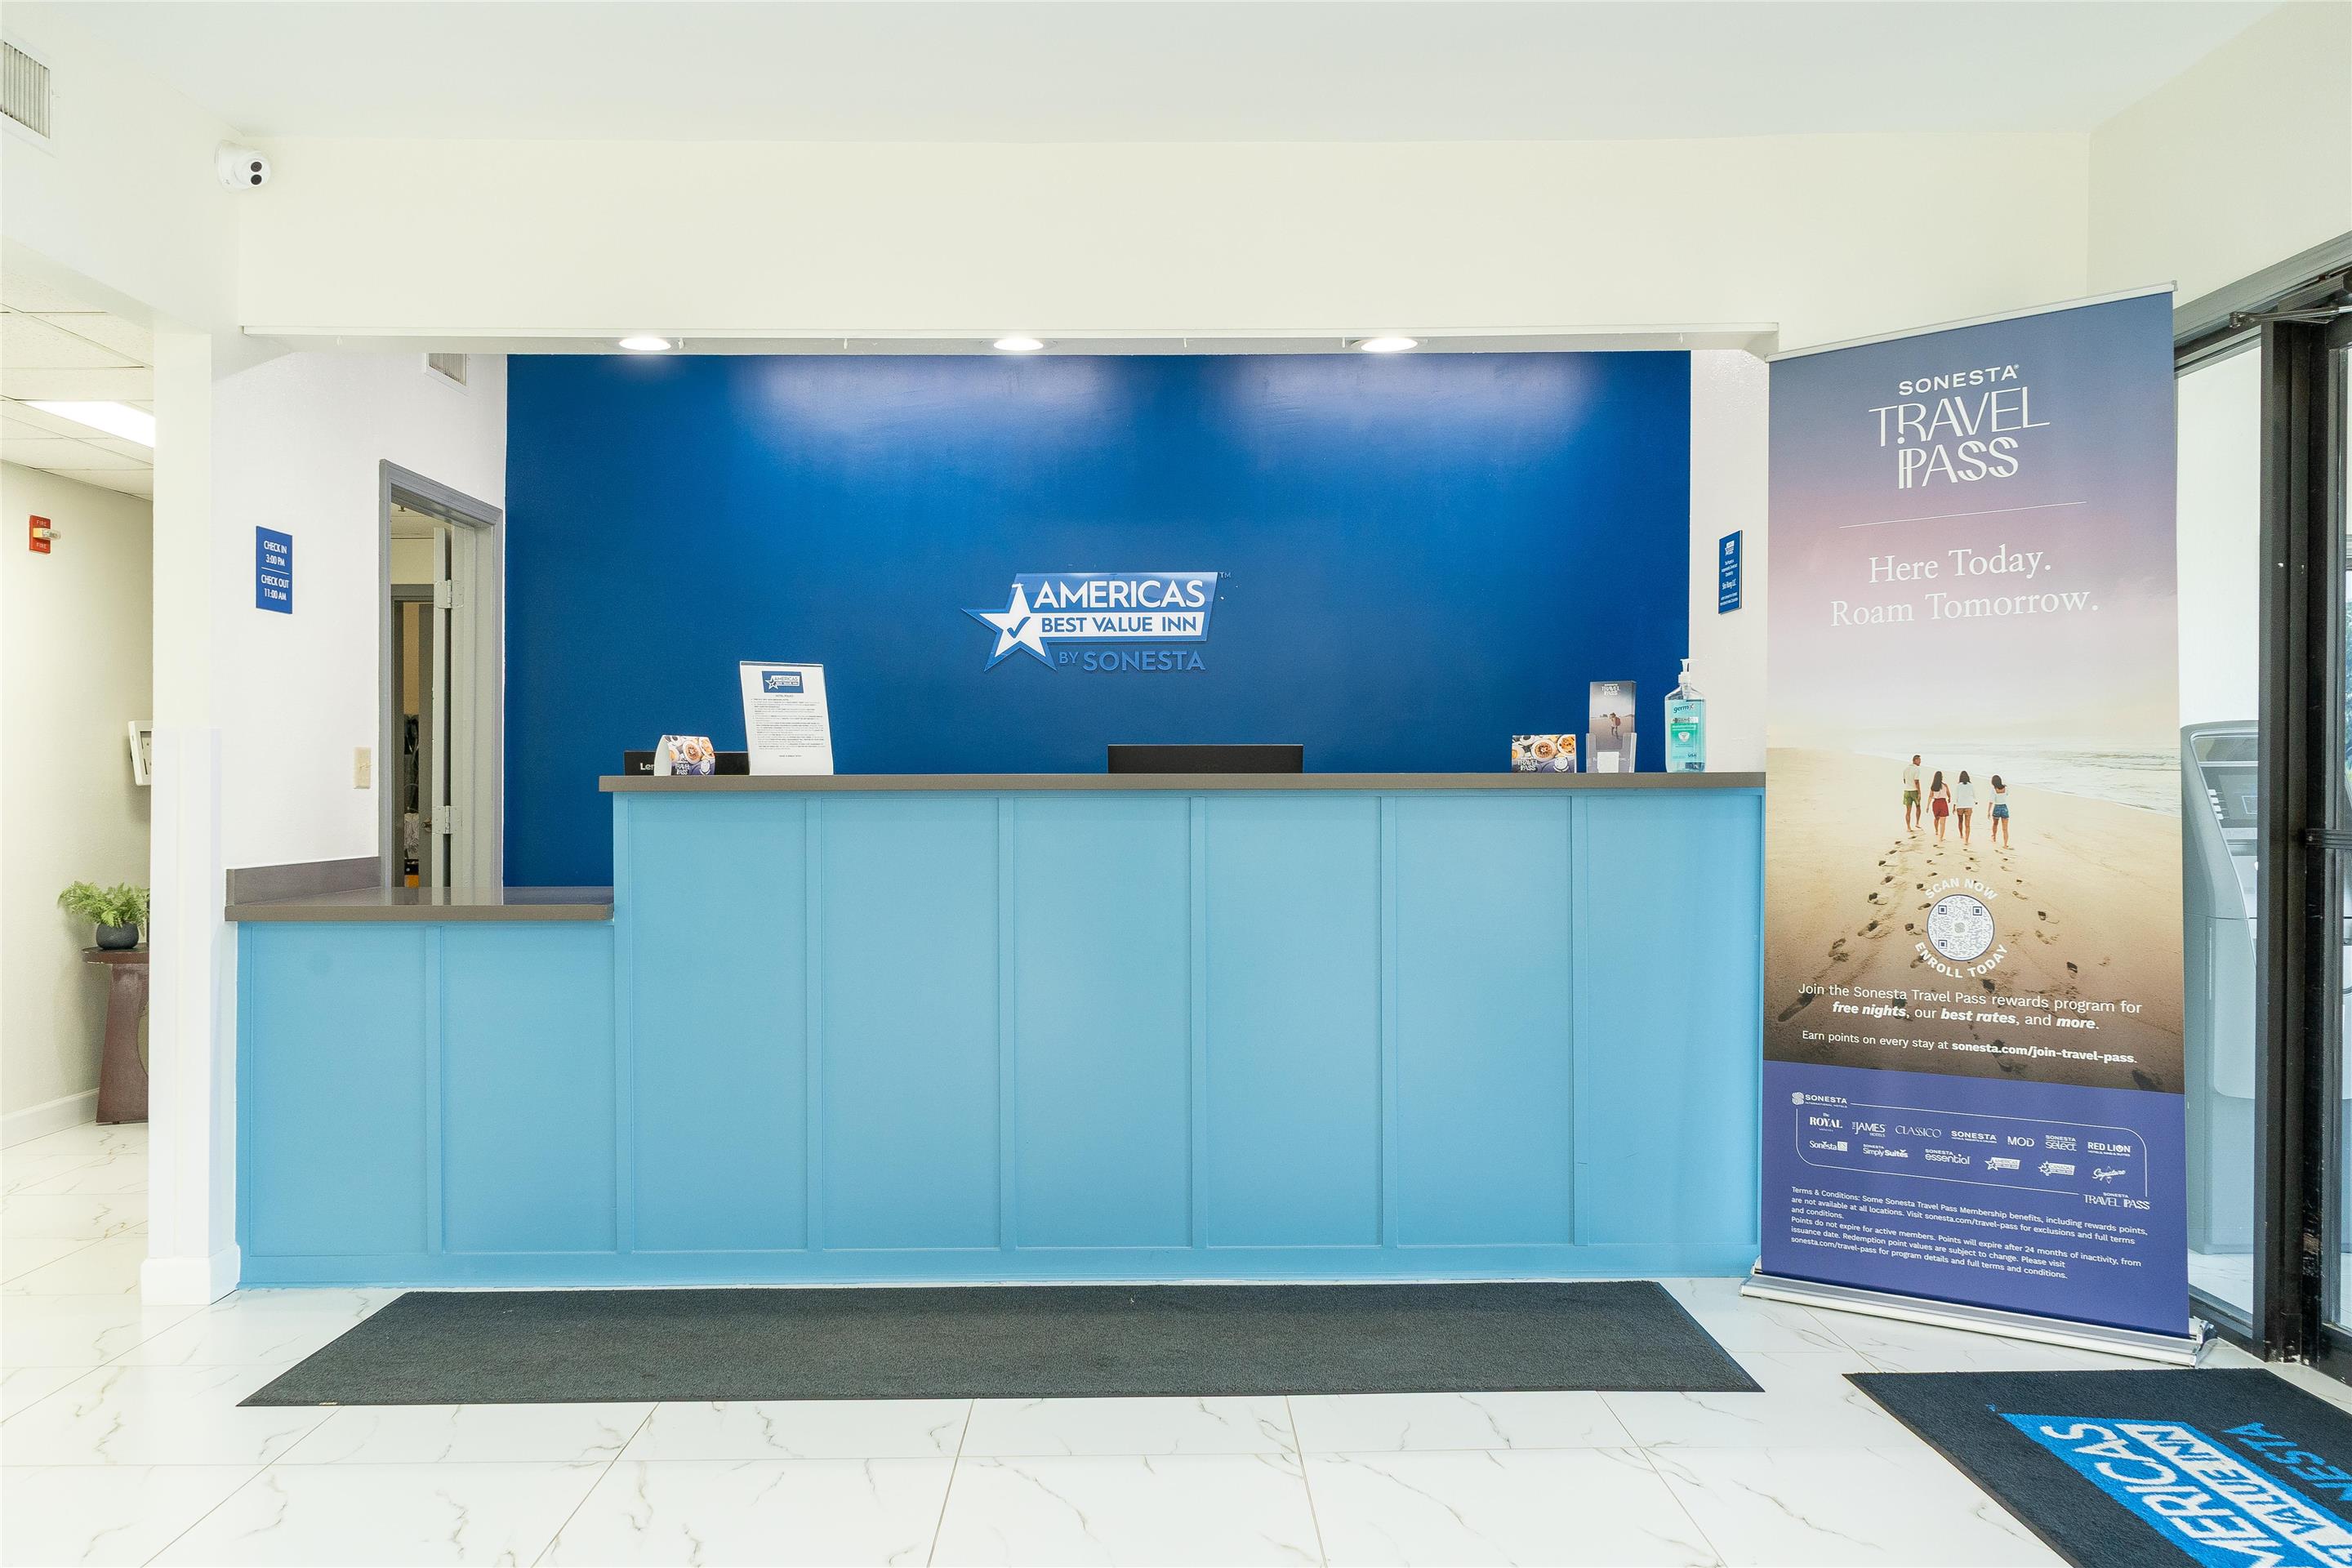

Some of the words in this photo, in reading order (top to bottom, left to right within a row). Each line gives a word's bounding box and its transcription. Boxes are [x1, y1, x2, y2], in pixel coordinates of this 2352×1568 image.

[1898, 365, 2018, 396] SONESTA
[1869, 385, 2051, 448] TRAVEL
[1898, 436, 2019, 489] PASS
[264, 540, 281, 553] CHECK
[280, 545, 287, 555] IN
[265, 554, 277, 565] 3:00
[278, 557, 285, 567] PM
[1869, 554, 1939, 584] Here
[1948, 542, 2051, 579] Today.
[261, 574, 278, 586] CHECK
[278, 578, 289, 589] OUT
[264, 588, 278, 599] 11:00
[278, 591, 287, 601] AM
[1033, 580, 1205, 608] AMERICAS
[1830, 600, 1915, 627] Roam
[1925, 590, 2099, 621] Tomorrow.
[1041, 617, 1087, 632] BEST
[1092, 617, 1153, 632] VALUE
[1162, 616, 1196, 632] INN
[1059, 652, 1079, 664] BY
[1083, 651, 1206, 670] SONESTA
[1924, 877, 1960, 899] SCAN
[1964, 878, 1999, 900] NOW
[1914, 942, 1963, 978] ENROLL
[1967, 944, 2008, 978] TODAY
[1798, 983, 1824, 995] Join
[1829, 984, 1850, 996] the
[1854, 987, 1907, 1000] Sonesta
[1911, 989, 1950, 1003] Travel
[1955, 991, 1987, 1004] Pass
[1992, 996, 2049, 1008] rewards
[2054, 999, 2115, 1013] program
[2120, 1000, 2142, 1013] for
[1832, 1001, 1859, 1014] free
[1862, 1004, 1910, 1018] nights,
[1914, 1009, 1937, 1018] our
[1940, 1008, 1973, 1022] best
[1976, 1012, 2020, 1026] rates,
[2025, 1013, 2051, 1027] and
[2056, 1018, 2100, 1030] more.
[1802, 1030, 1824, 1040] Earn
[1828, 1031, 1860, 1044] points
[1863, 1036, 1876, 1045] on
[1879, 1037, 1909, 1049] every
[1912, 1039, 1935, 1051] stay
[1937, 1041, 1949, 1050] at
[1952, 1042, 2138, 1064] sonesta.com/join-travel-pass.
[1805, 1094, 1847, 1104] SONESTA
[1809, 1116, 1843, 1129] ROYAL
[1855, 1121, 1886, 1134] JAMES
[1895, 1125, 1942, 1138] CLASSICO
[1809, 1140, 1837, 1151] Sonesta
[1950, 1130, 1997, 1141] SONESTA
[2007, 1136, 2035, 1147] MOD
[1863, 1148, 1885, 1157] Simply
[1885, 1149, 1908, 1158] Suites
[2046, 1141, 2078, 1152] select
[2087, 1142, 2105, 1151] RED
[2107, 1144, 2131, 1153] LION
[1925, 1153, 1971, 1165] essential
[1792, 1187, 1812, 1195] Terms
[1821, 1191, 1860, 1200] Conditions:
[1862, 1195, 1883, 1204] Some
[1885, 1198, 1915, 1207] Sonesta
[1917, 1201, 1939, 1210] Travel
[1960, 1207, 2007, 1219] Membership
[2009, 1212, 2043, 1223] benefits,
[2046, 1216, 2082, 1228] including
[2084, 1223, 2117, 1232] rewards
[2119, 1226, 2148, 1236] points,
[2083, 1194, 2122, 1208] TRAVEL
[2124, 1198, 2150, 1210] PASS
[1806, 1209, 1844, 1219] conditions.
[1818, 1201, 1847, 1209] available
[1869, 1206, 1904, 1216] locations.
[1906, 1210, 1923, 1218] Visit
[1925, 1214, 2018, 1230] sonesta.com/travel-pass
[2034, 1227, 2075, 1236] exclusions
[2095, 1232, 2108, 1241] full
[2110, 1236, 2136, 1245] terms
[1791, 1216, 1813, 1225] Points
[1839, 1223, 1861, 1232] expire
[1875, 1227, 1896, 1236] active
[1899, 1231, 1936, 1241] members.
[1938, 1235, 1962, 1244] Points
[1979, 1241, 2002, 1250] expire
[2005, 1244, 2023, 1252] after
[2037, 1248, 2068, 1258] months
[2081, 1253, 2118, 1265] inactivity,
[2120, 1258, 2141, 1267] from
[1791, 1226, 1821, 1236] issuance
[1823, 1230, 1841, 1239] date.
[1842, 1233, 1886, 1244] Redemption
[1888, 1240, 1907, 1248] point
[1909, 1242, 1932, 1250] values
[1949, 1247, 1976, 1257] subject
[1989, 1253, 2019, 1263] change.
[2021, 1256, 2047, 1265] Please
[2048, 1259, 2065, 1268] visit
[1791, 1237, 1877, 1254] sonesta.com/travel-pass
[1878, 1247, 1889, 1255] for
[1891, 1250, 1922, 1259] program
[1924, 1254, 1949, 1263] details
[1967, 1259, 1980, 1267] full
[1981, 1262, 2005, 1271] terms
[2024, 1268, 2069, 1279] conditions.
[2137, 1426, 2222, 1462] INN
[2039, 1423, 2314, 1568] MERICAS
[2197, 1469, 2328, 1535] VALUE
